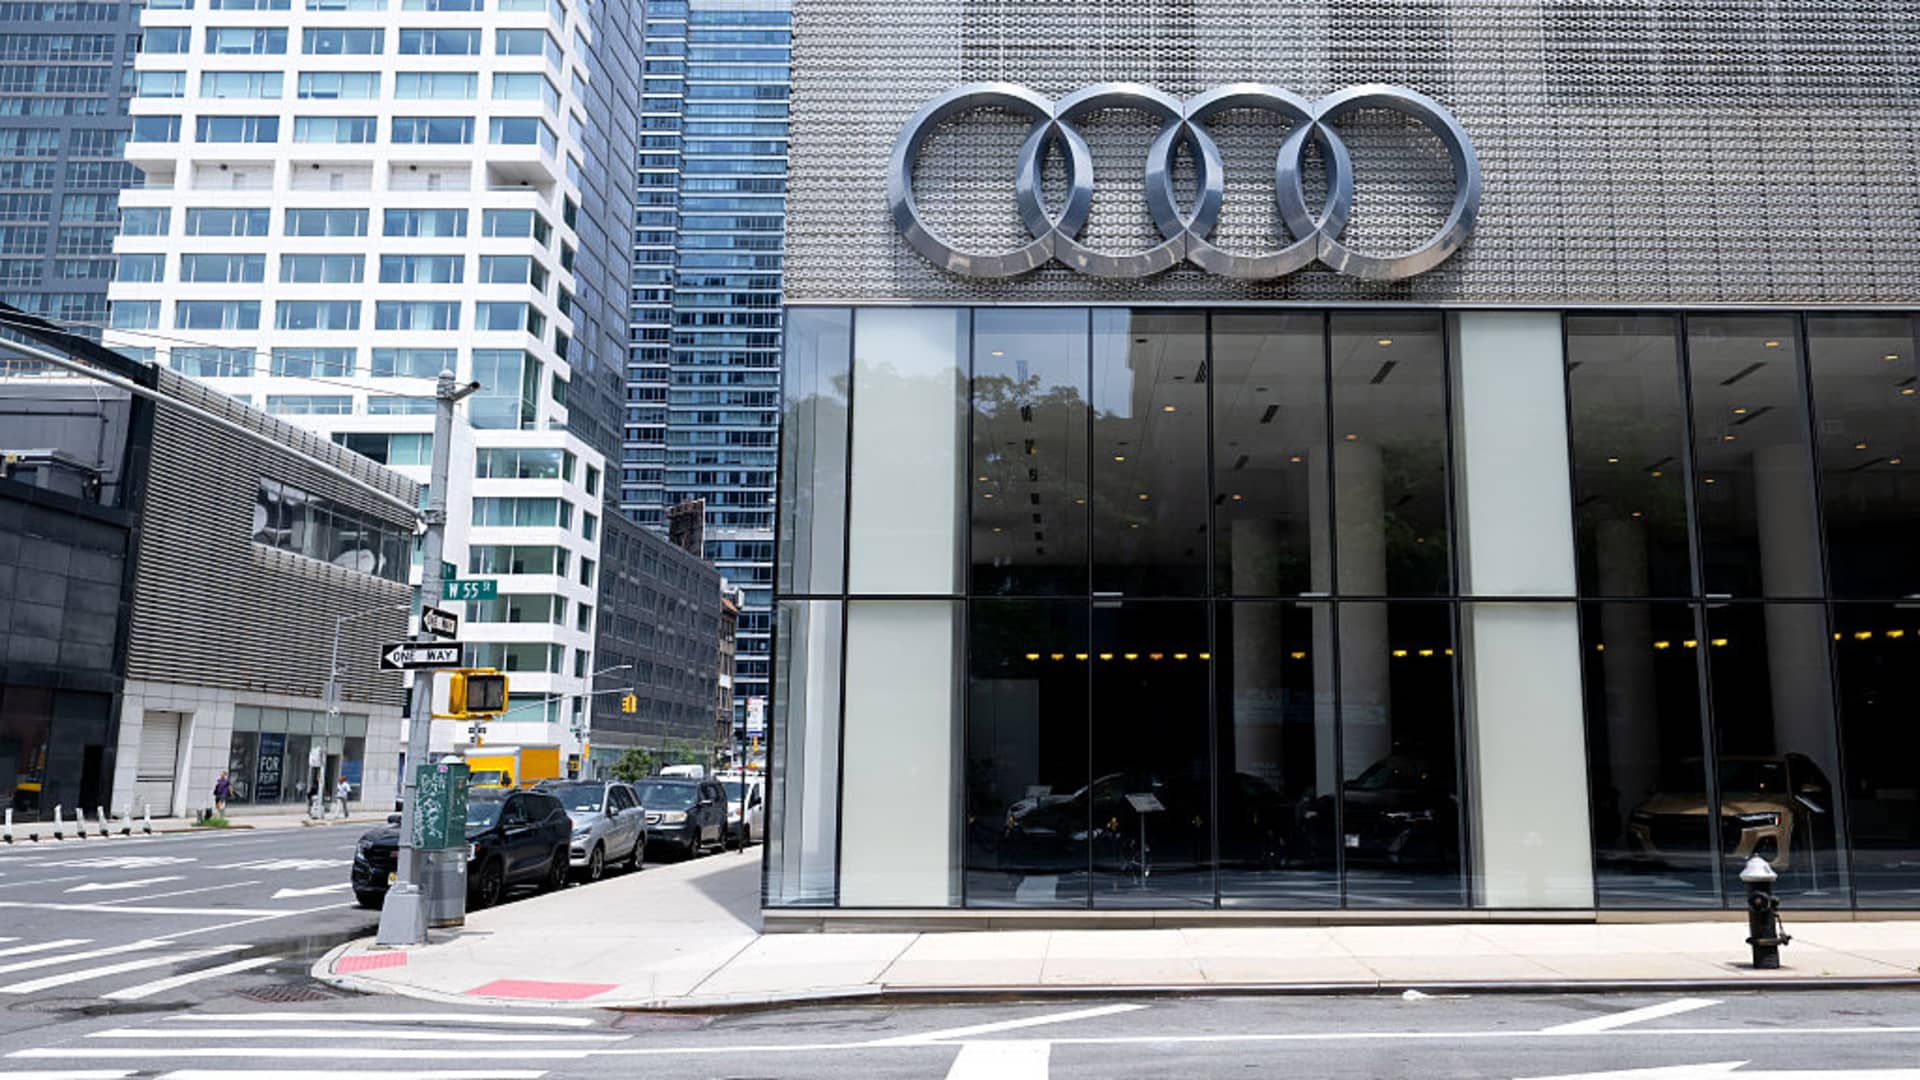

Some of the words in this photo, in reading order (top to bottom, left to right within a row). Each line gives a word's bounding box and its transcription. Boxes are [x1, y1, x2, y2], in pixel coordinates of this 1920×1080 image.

[449, 583, 459, 598] W
[463, 582, 479, 599] 55
[393, 650, 415, 662] ONE
[427, 650, 453, 661] WAY
[260, 756, 280, 771] FOR
[258, 772, 279, 785] RENT
